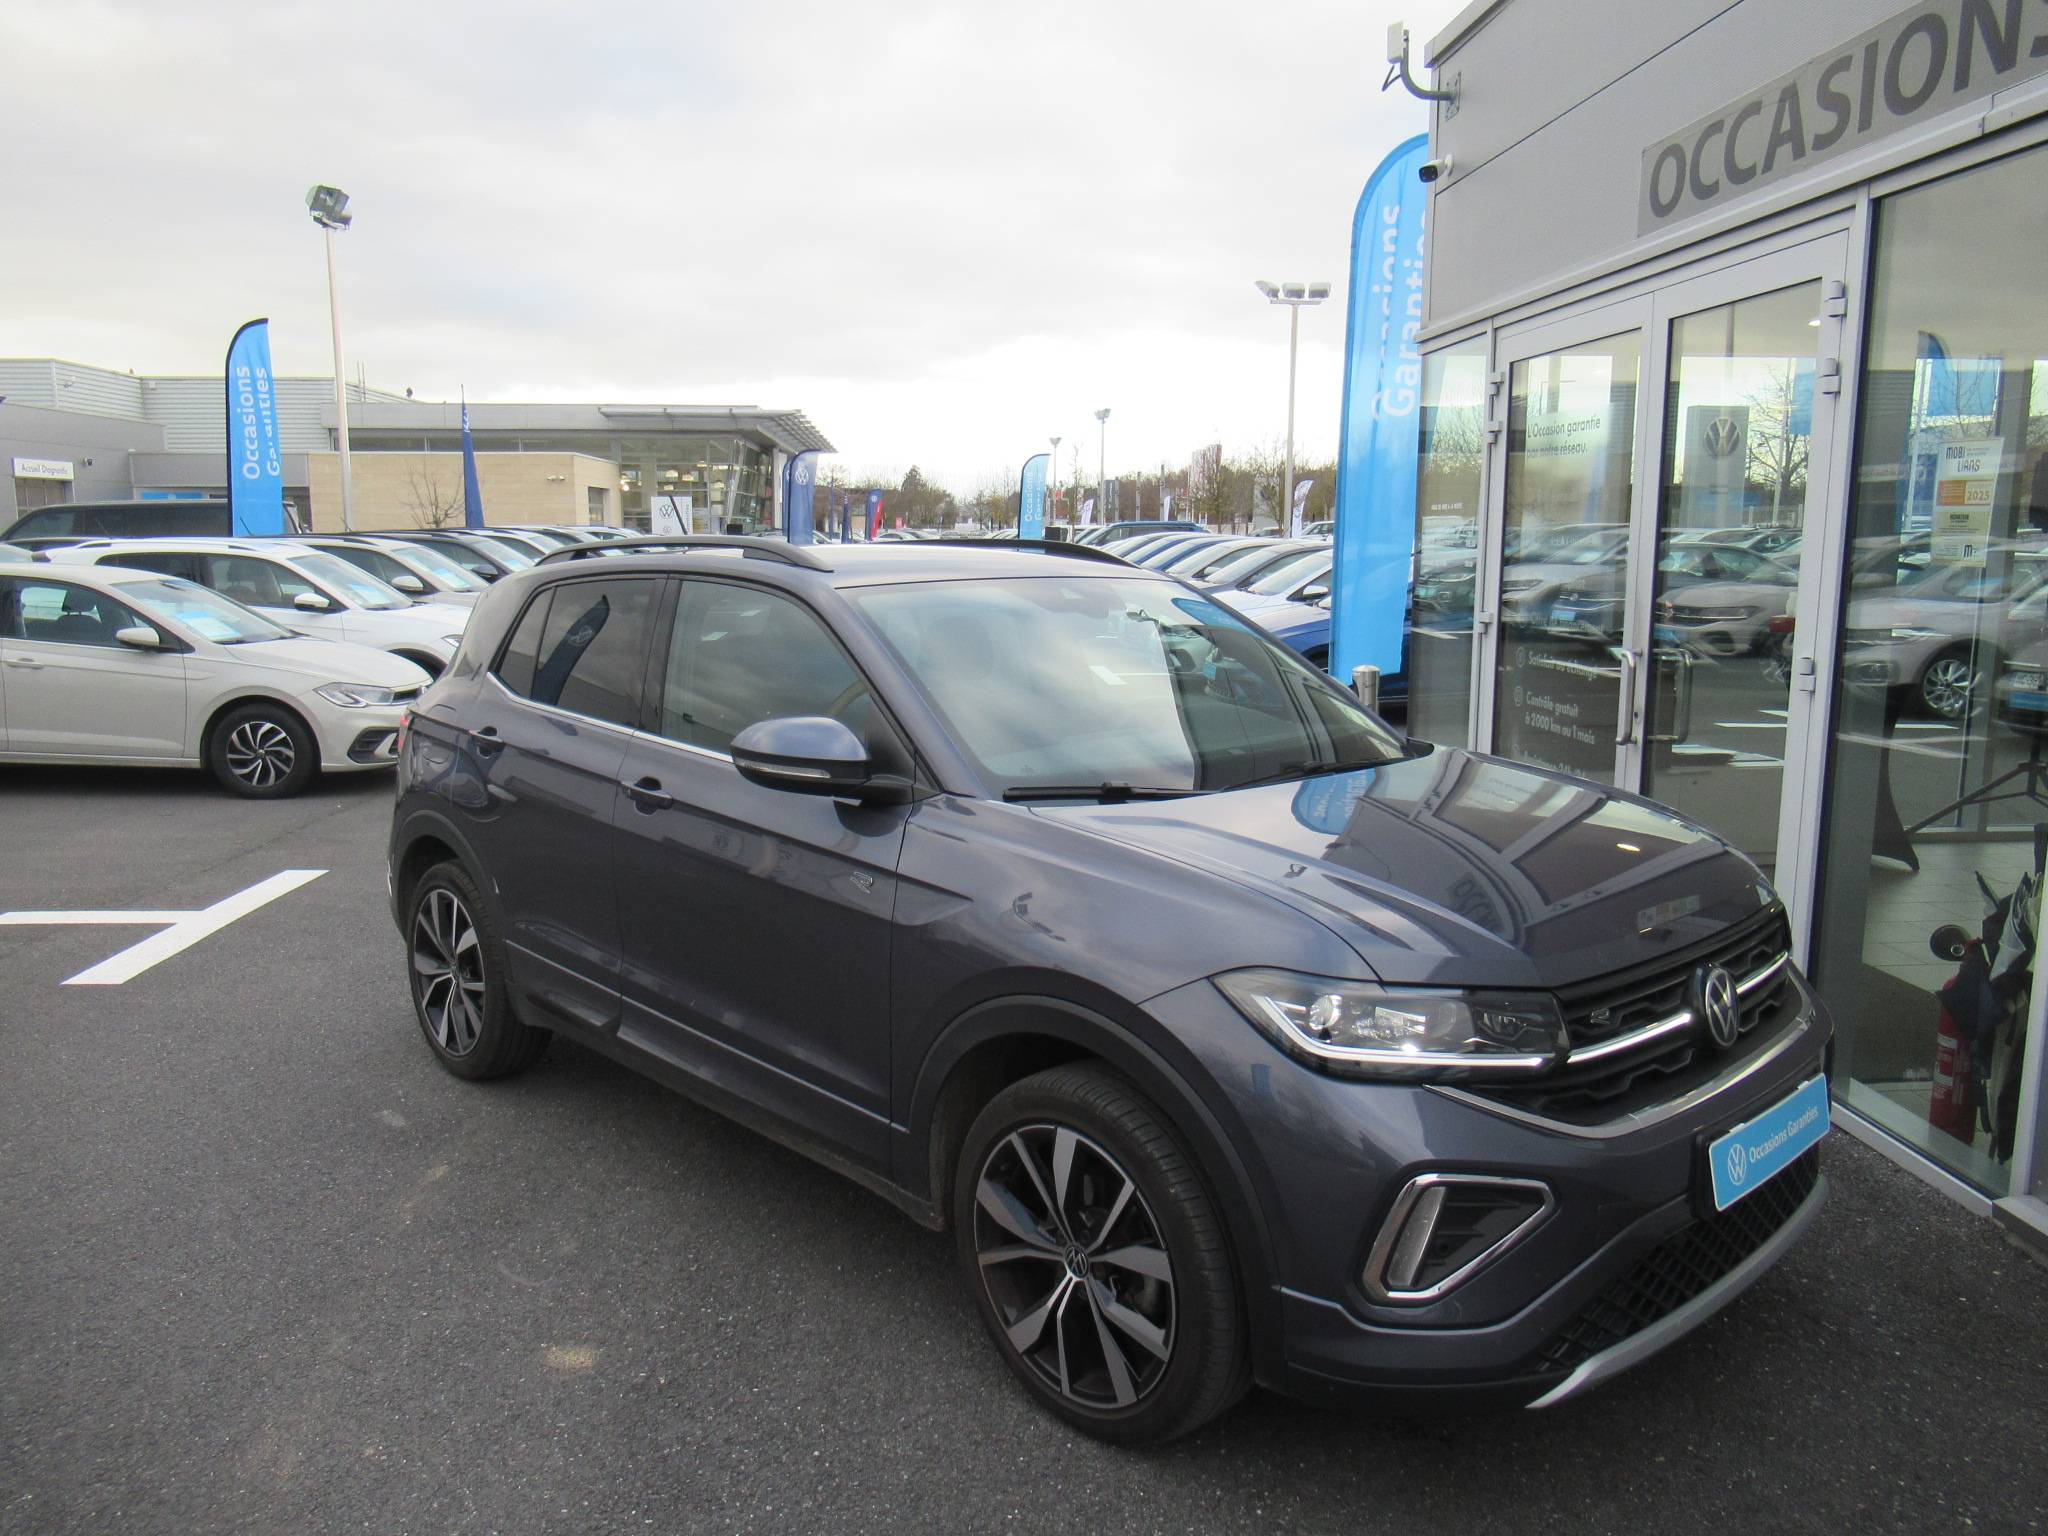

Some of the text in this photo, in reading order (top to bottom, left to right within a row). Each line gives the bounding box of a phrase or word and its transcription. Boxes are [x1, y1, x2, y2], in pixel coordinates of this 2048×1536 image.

[237, 366, 260, 480] Occasions
[1527, 414, 1601, 438] L'Occasion garantie
[1526, 691, 1578, 717] Contrôle gratuit
[1551, 718, 1560, 733] km
[1562, 726, 1571, 737] ou
[1577, 729, 1595, 745] mois
[1749, 1131, 1787, 1163] Occasions
[1787, 1106, 1818, 1137] Garanties
